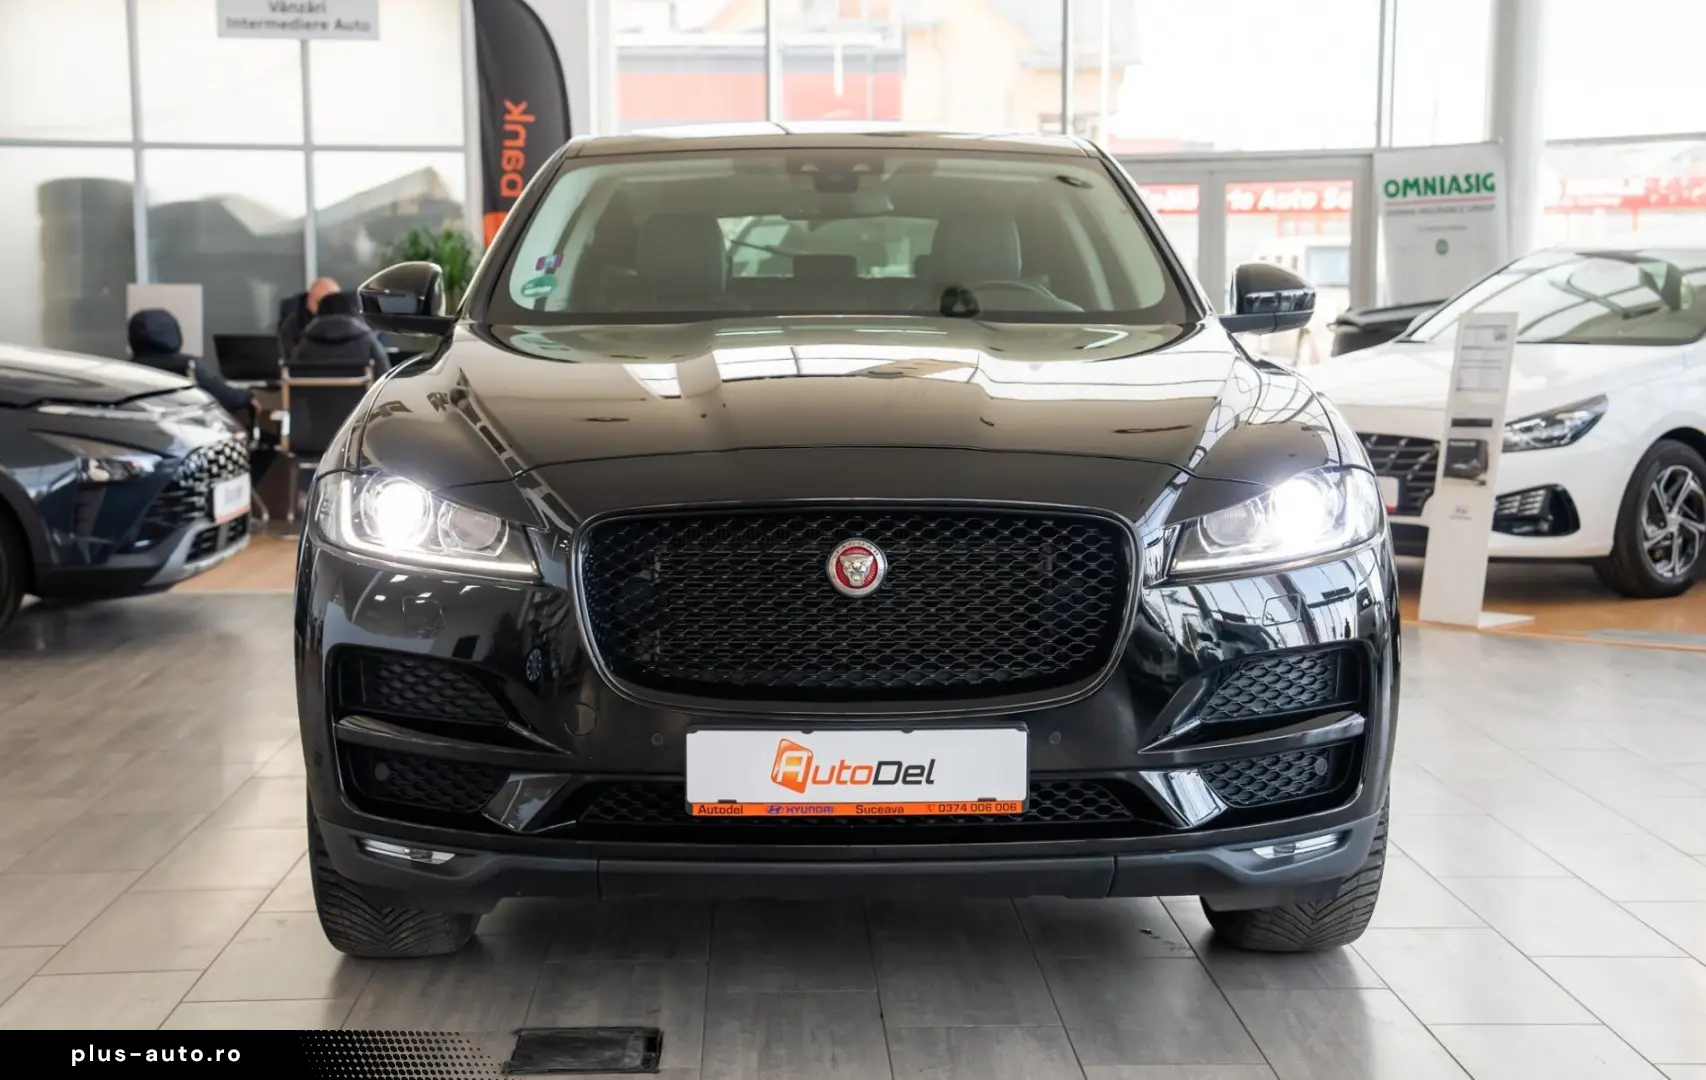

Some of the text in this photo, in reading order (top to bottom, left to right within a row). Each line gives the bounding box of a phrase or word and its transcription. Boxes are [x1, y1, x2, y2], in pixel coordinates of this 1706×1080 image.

[334, 18, 372, 32] Auto
[1384, 172, 1495, 198] OMNIASIG
[774, 747, 936, 787] AutoDel
[697, 802, 1018, 815] Autodel HYUNDAI Suceava 0374 006 006
